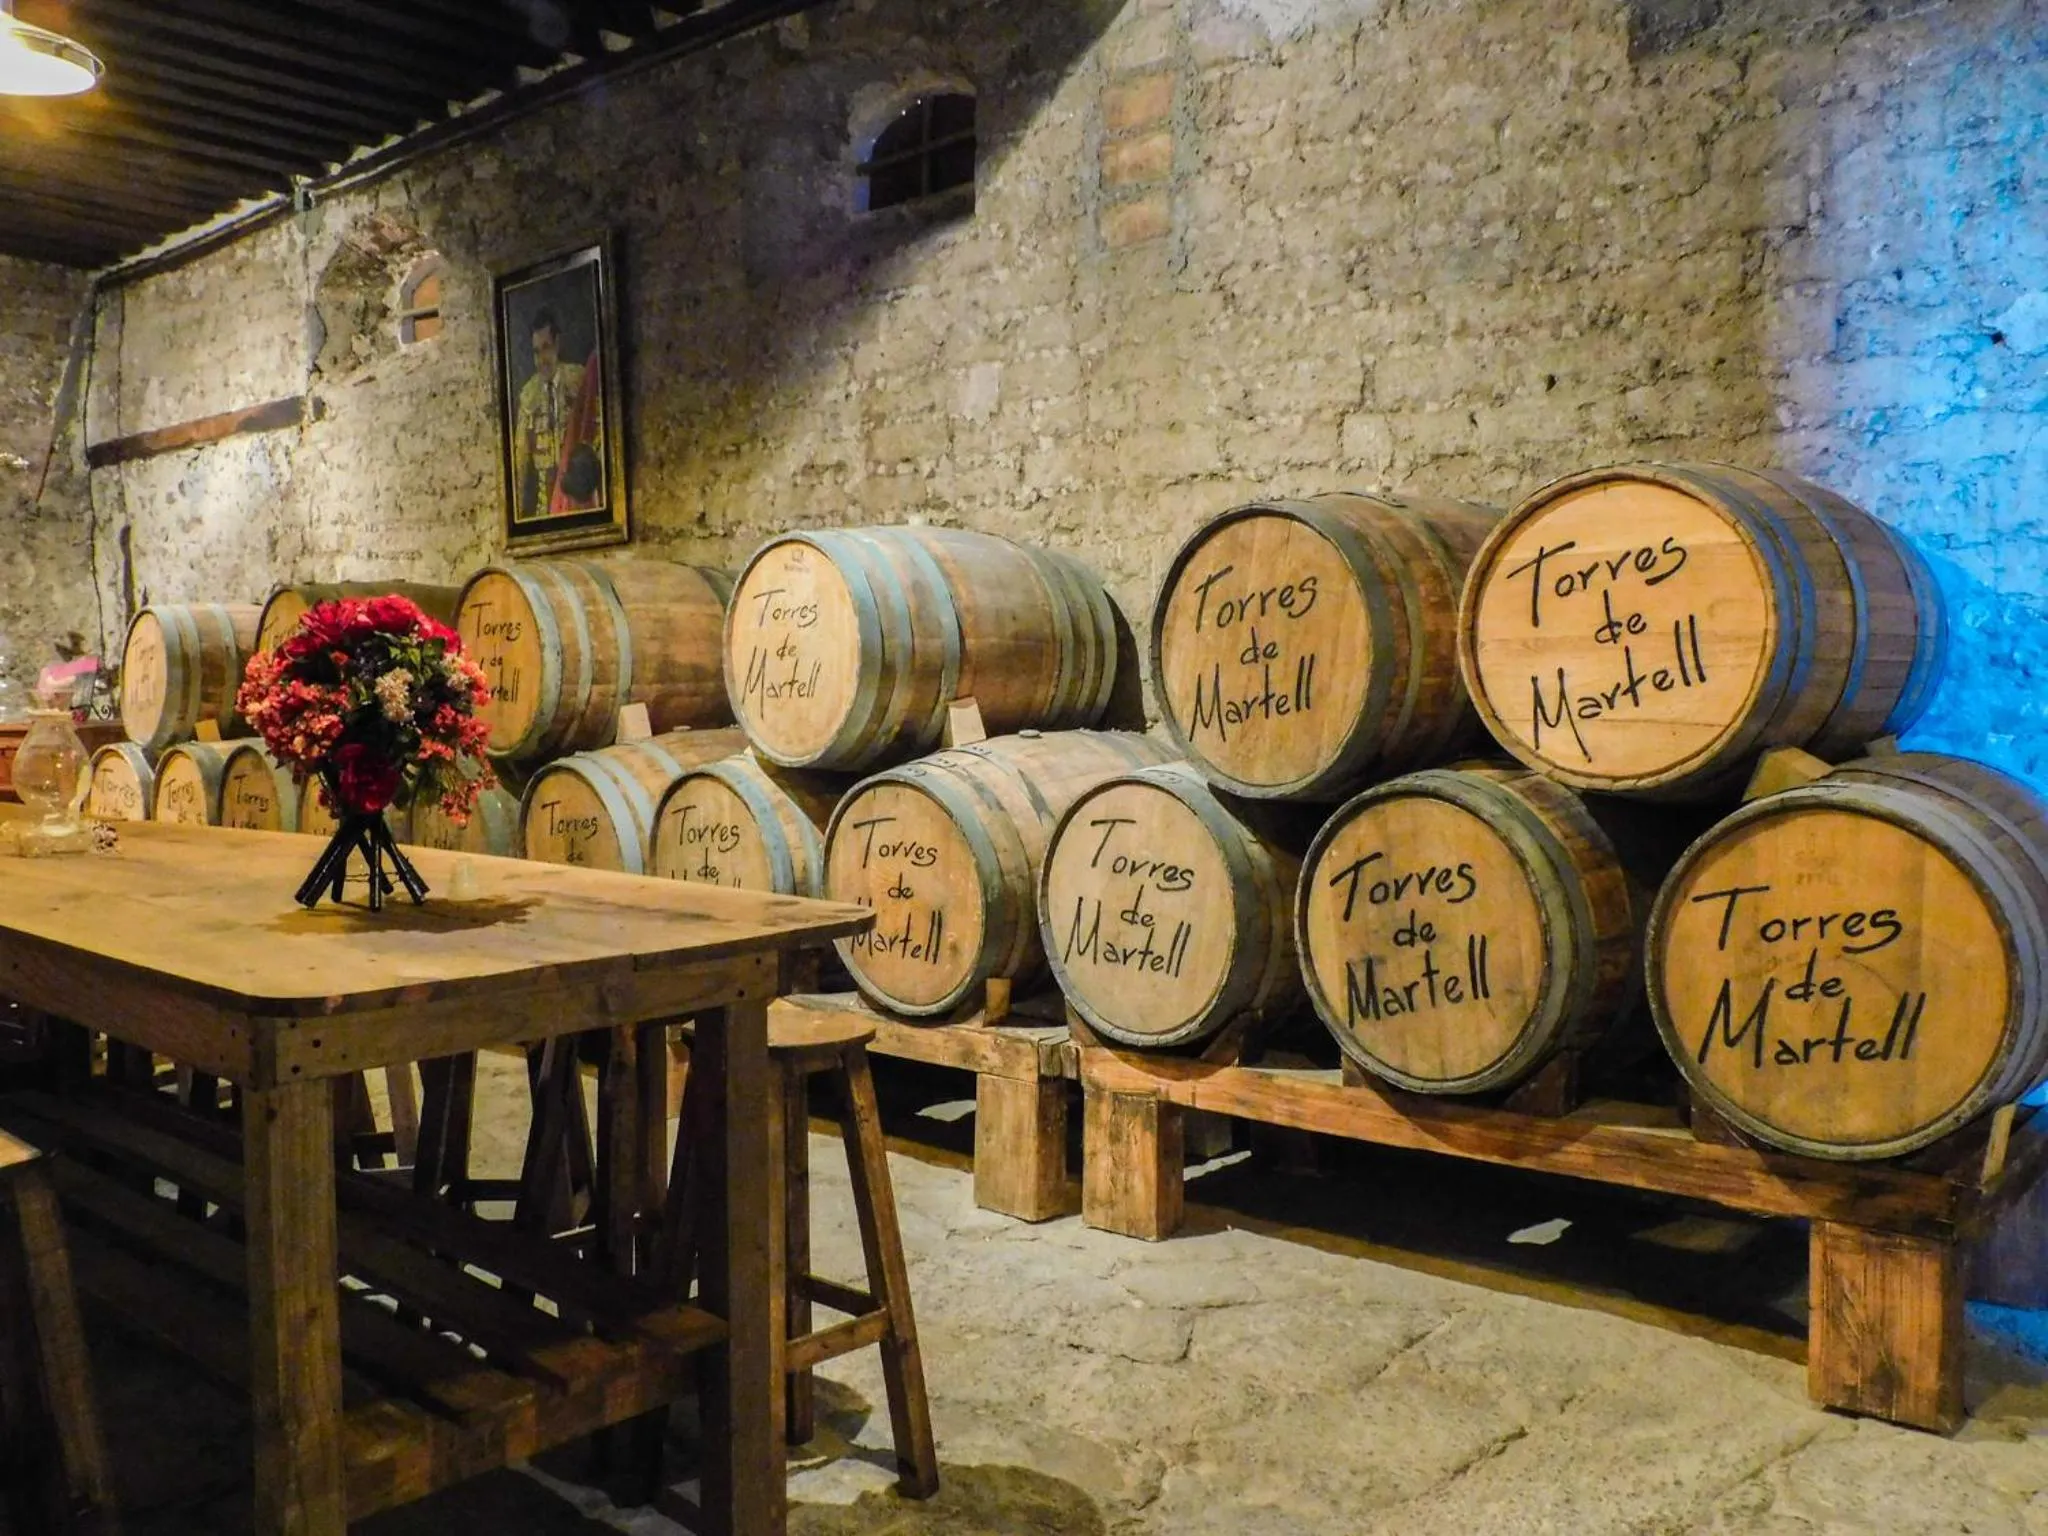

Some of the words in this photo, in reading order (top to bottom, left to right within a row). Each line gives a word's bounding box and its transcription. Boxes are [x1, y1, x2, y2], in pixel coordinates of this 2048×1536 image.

[1194, 565, 1318, 633] Torres
[1507, 536, 1688, 628] Torres
[469, 602, 521, 642] Torres
[753, 589, 818, 628] Torres
[1594, 589, 1648, 644] de
[490, 643, 503, 667] de
[776, 633, 797, 661] de
[1240, 626, 1279, 666] de
[742, 645, 822, 721] Martell
[1188, 653, 1315, 743] Martell
[1530, 614, 1706, 763] Martell
[101, 768, 135, 808] Torres
[165, 778, 195, 809] Torres
[233, 774, 270, 813] Torres
[541, 800, 599, 840] Torres
[672, 805, 740, 853] Torres
[853, 817, 938, 868] Torres
[565, 837, 584, 863] de
[697, 847, 719, 880] de
[1090, 818, 1194, 892] Torres
[887, 872, 914, 899] de
[1120, 884, 1156, 927] de
[1329, 851, 1477, 922] Torres
[1064, 896, 1192, 978] Martell
[1392, 909, 1437, 947] de
[1691, 885, 1902, 953] Torres
[1345, 934, 1490, 1030] Martell
[1785, 947, 1846, 1002] de
[1697, 977, 1927, 1069] Martell
